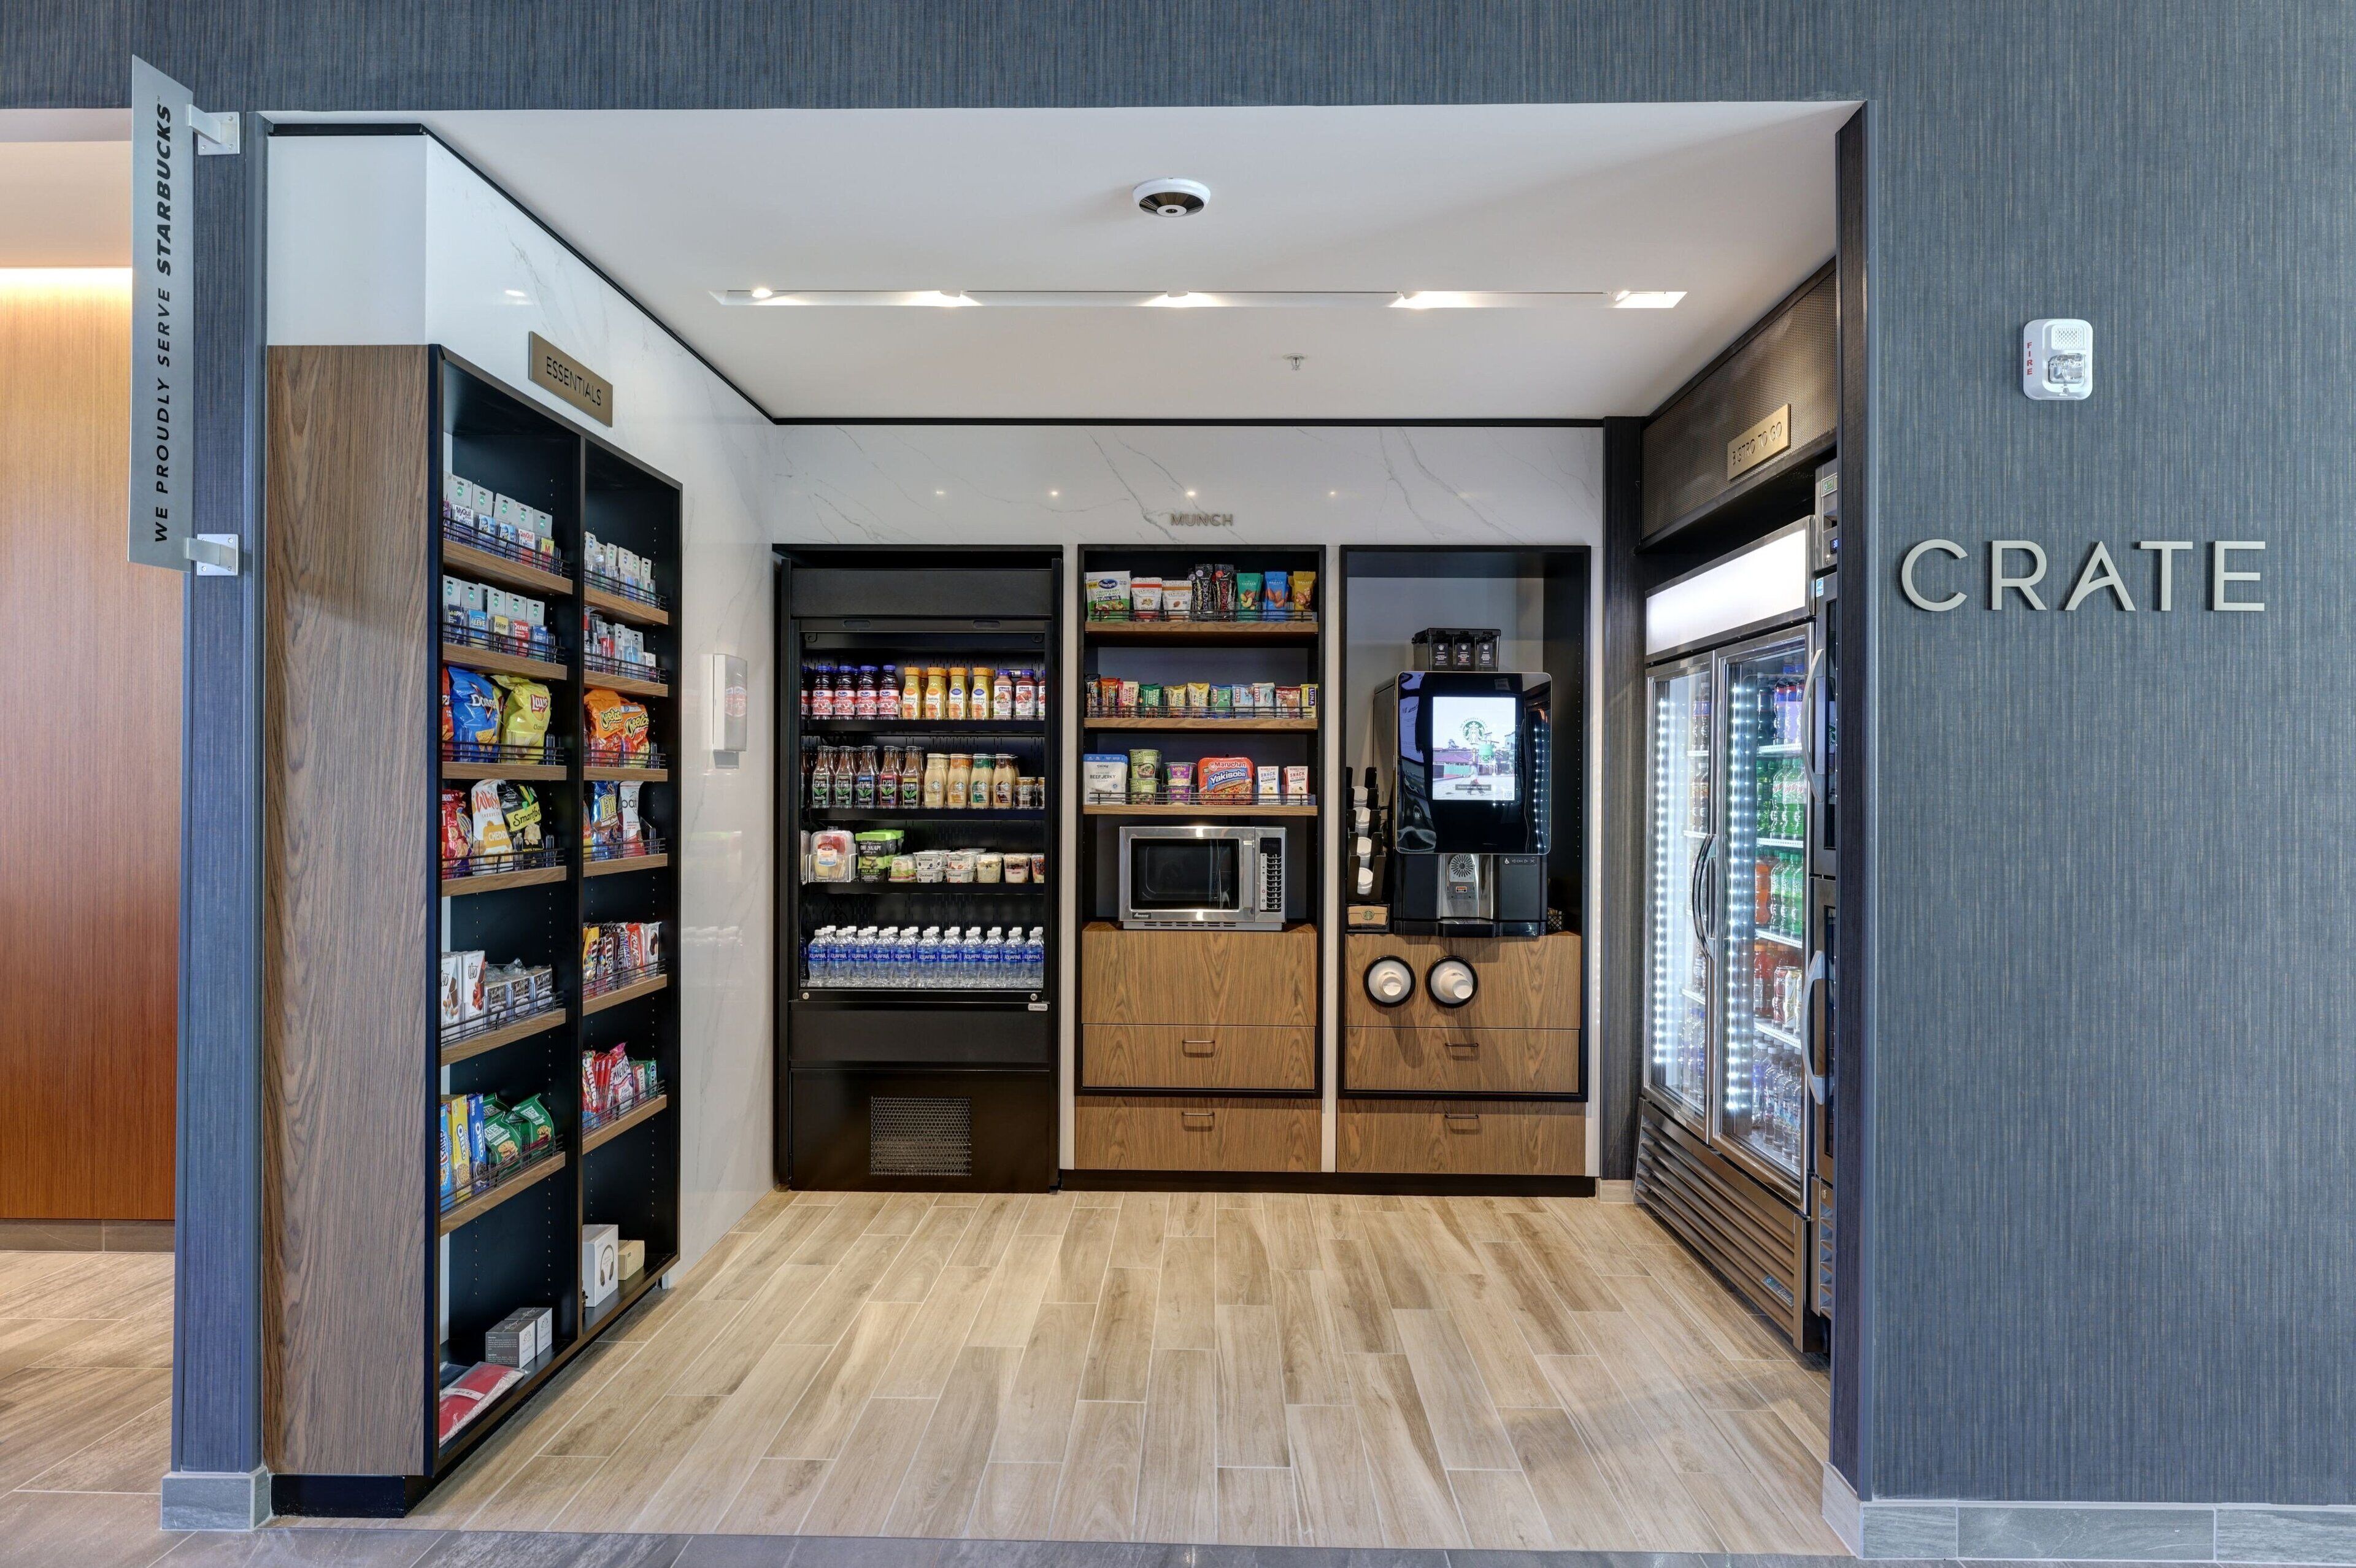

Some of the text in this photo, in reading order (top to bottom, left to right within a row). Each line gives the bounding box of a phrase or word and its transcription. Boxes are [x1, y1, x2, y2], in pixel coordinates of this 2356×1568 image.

[157, 103, 171, 276] STARBUCKS
[157, 288, 171, 367] SERVE
[546, 355, 602, 407] ESSENTIALS
[156, 378, 170, 494] PROUDLY
[1758, 431, 1768, 449] TO
[1769, 421, 1782, 442] GO
[155, 507, 168, 542] WE
[1170, 513, 1233, 526] MUNCH
[1901, 539, 2266, 612] CRATE
[470, 617, 485, 626] ALEVE
[1209, 771, 1247, 785] Yakisoba
[456, 1123, 466, 1160] OREO
[474, 1122, 483, 1158] OREO
